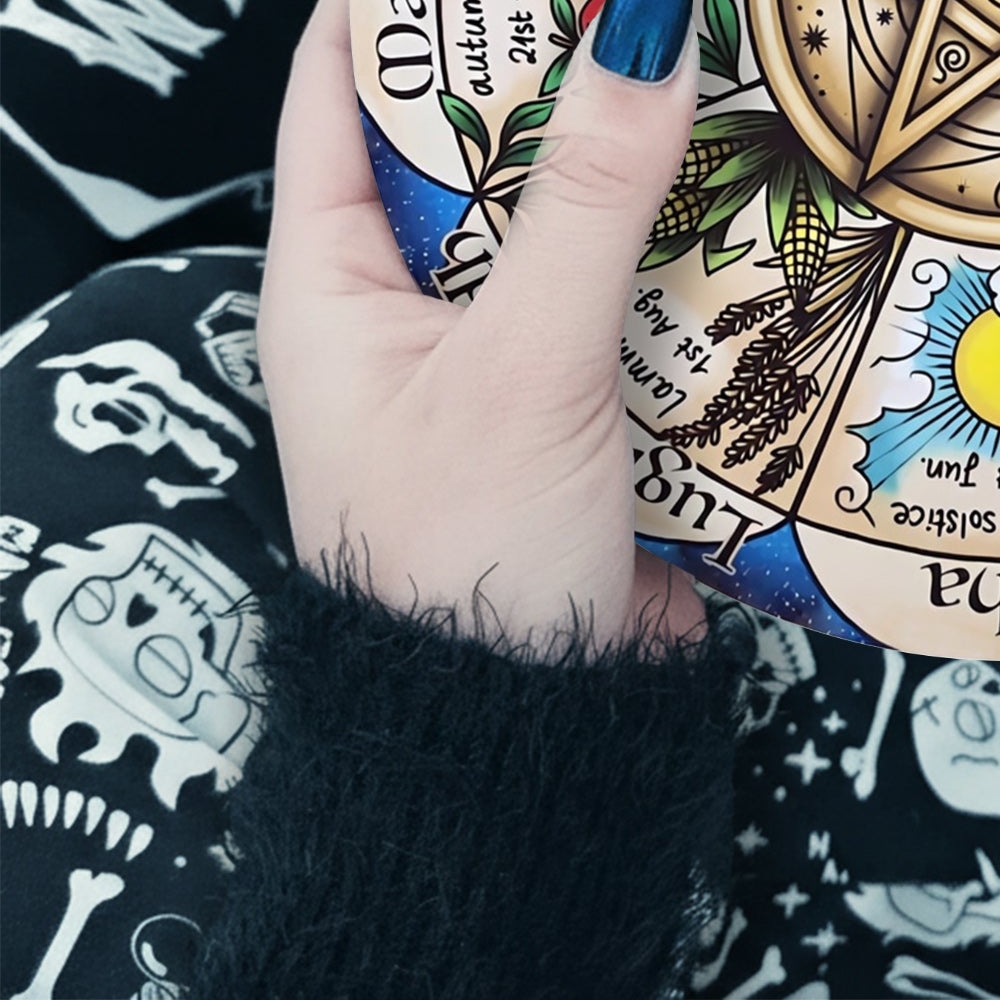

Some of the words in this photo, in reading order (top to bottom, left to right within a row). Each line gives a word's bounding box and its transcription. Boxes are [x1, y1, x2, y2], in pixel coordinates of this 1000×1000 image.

[633, 286, 679, 336] Aug.
[620, 337, 687, 419] Lamm
[673, 336, 712, 376] 1st
[921, 452, 979, 487] Jun.
[634, 446, 763, 570] Lug
